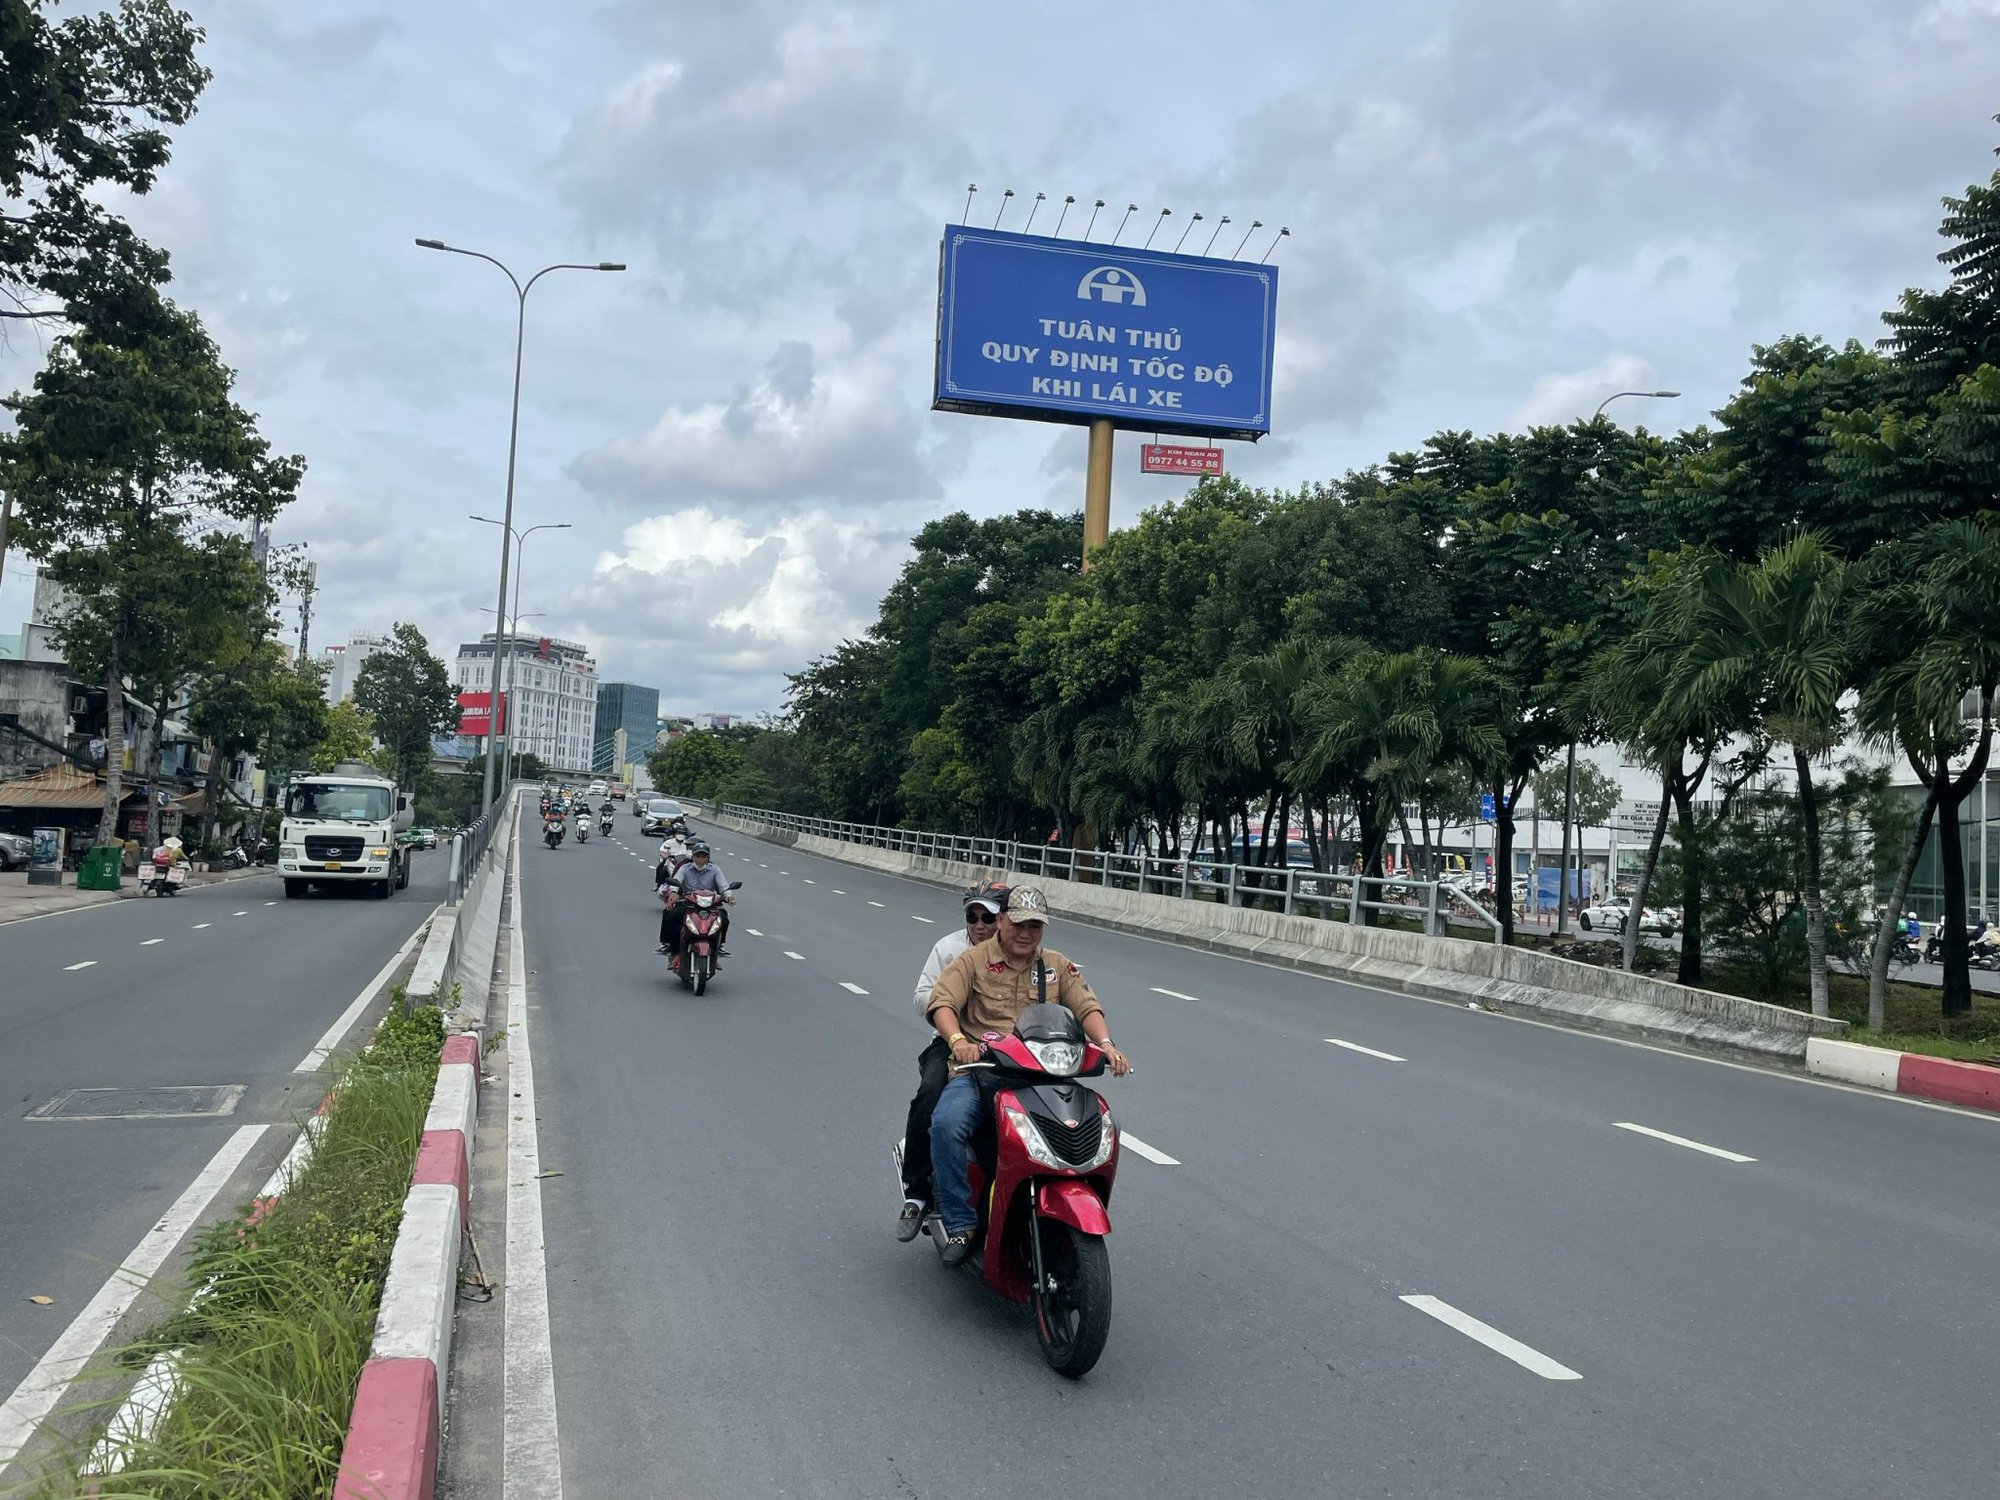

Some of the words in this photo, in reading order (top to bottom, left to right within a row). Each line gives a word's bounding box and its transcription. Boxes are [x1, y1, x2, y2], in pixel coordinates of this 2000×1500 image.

[1039, 318, 1115, 343] TUÂN
[1125, 328, 1181, 351] THỦ
[982, 341, 1040, 363] QUY
[1049, 350, 1118, 373] ĐỊNH
[1128, 356, 1185, 380] TỐC
[1194, 364, 1233, 388] ĐỘ
[1032, 376, 1081, 397] KHI
[1092, 382, 1137, 403] LÁI
[1147, 389, 1183, 408] XE
[1148, 456, 1172, 465] 0977
[1175, 458, 1188, 466] 44
[1191, 459, 1203, 467] 55
